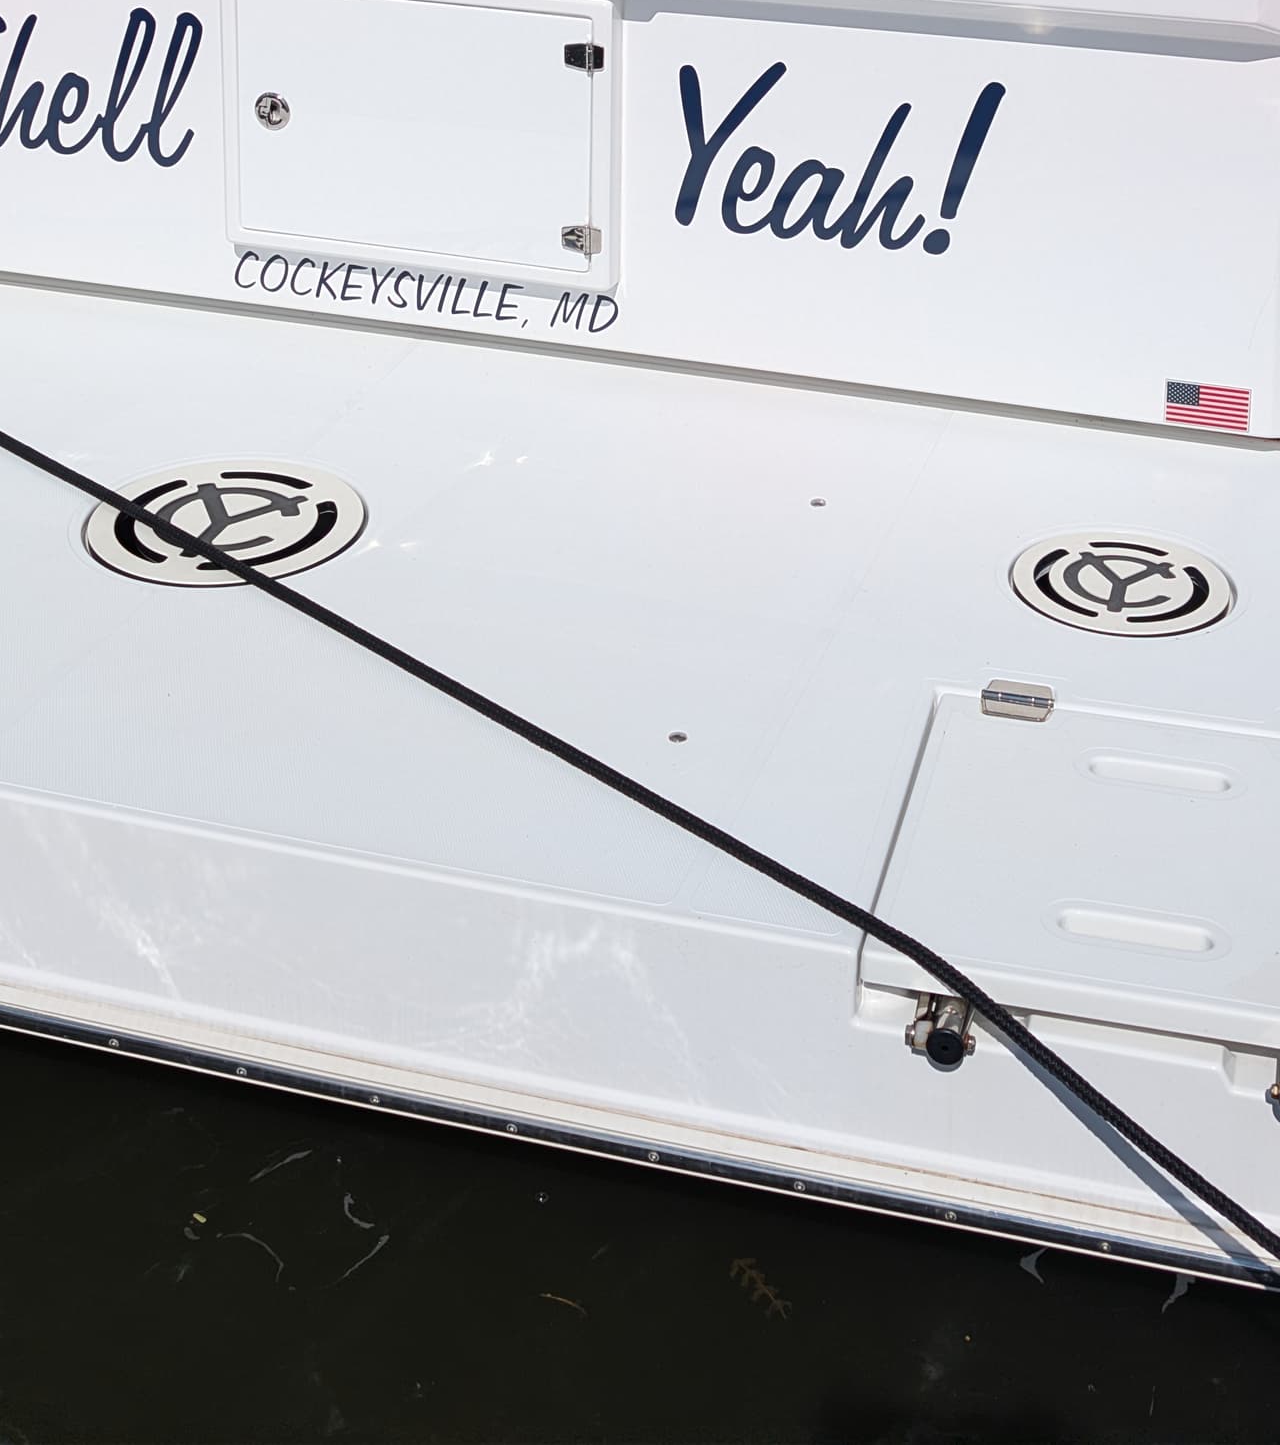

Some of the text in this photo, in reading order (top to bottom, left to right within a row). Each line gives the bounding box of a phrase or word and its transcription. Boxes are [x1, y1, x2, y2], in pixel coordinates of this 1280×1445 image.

[674, 61, 1007, 255] Yeah!
[233, 250, 619, 333] COCKEYSVILLE, MD
